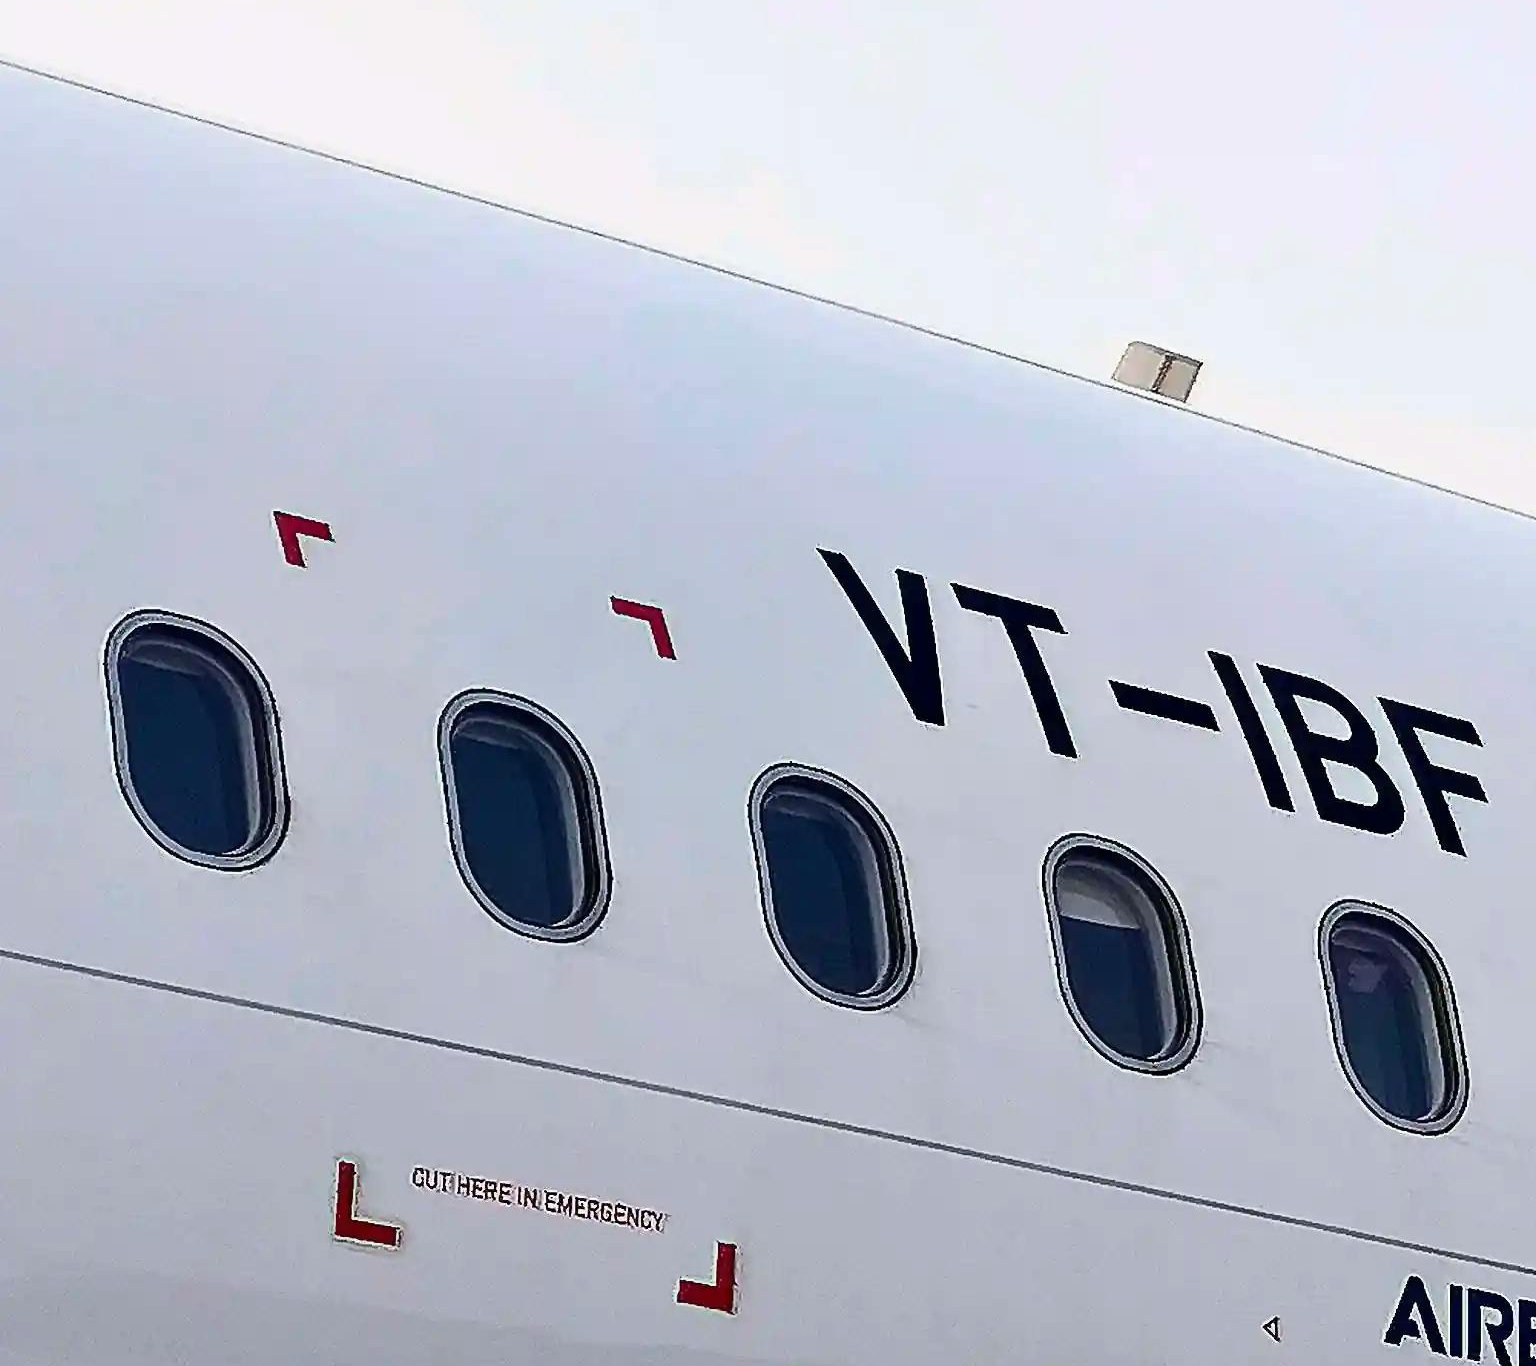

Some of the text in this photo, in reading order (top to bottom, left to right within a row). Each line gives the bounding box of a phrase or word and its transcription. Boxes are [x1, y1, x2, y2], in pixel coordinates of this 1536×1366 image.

[815, 547, 1489, 858] VT-IBF
[412, 1167, 664, 1232] CUT HERE IN EMERGENCY
